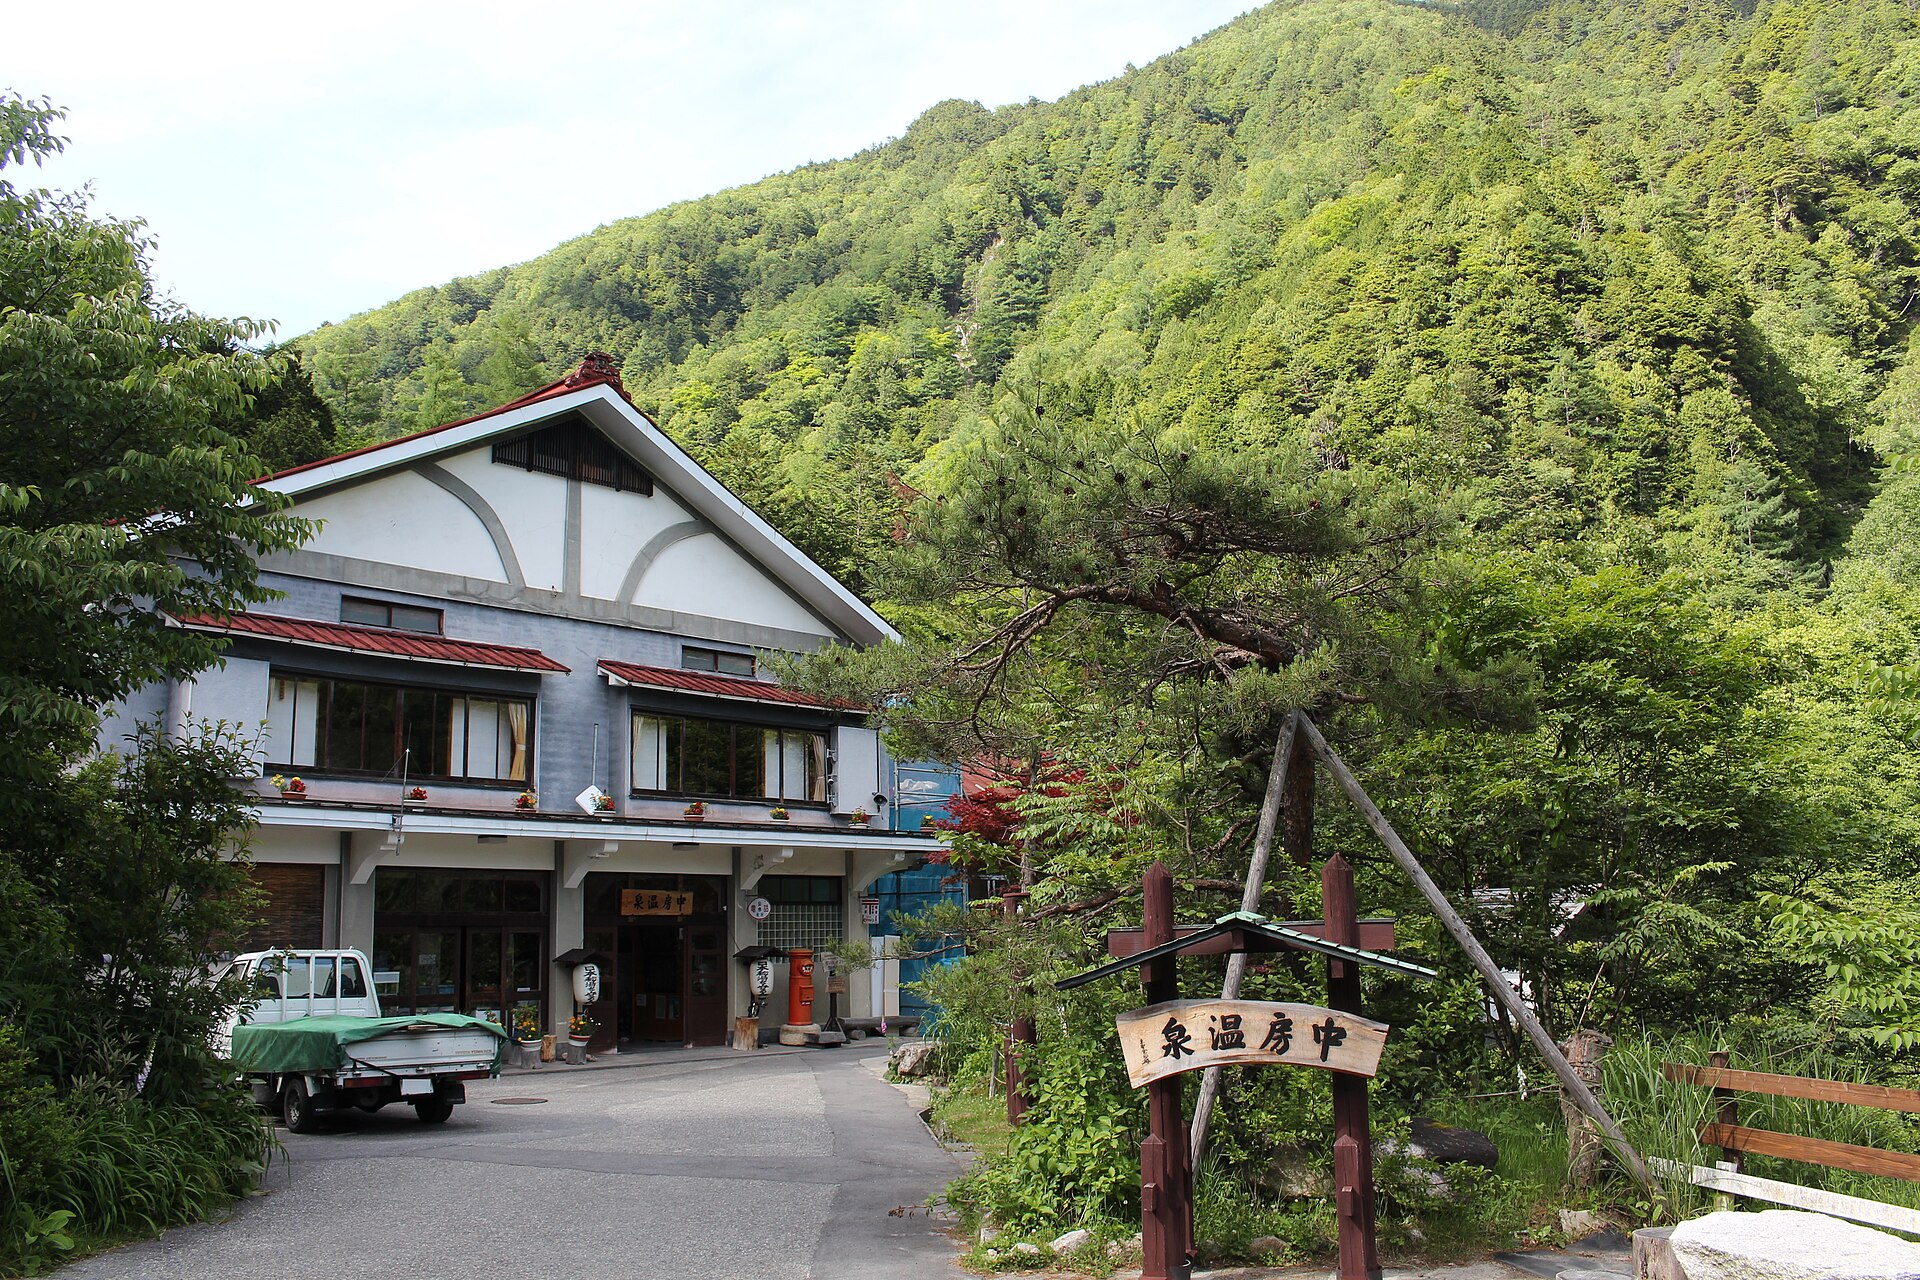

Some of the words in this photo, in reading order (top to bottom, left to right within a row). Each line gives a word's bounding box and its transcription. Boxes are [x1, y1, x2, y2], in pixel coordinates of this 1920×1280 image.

[634, 893, 687, 911] 中房温泉
[1161, 1012, 1347, 1062] 中房温泉
